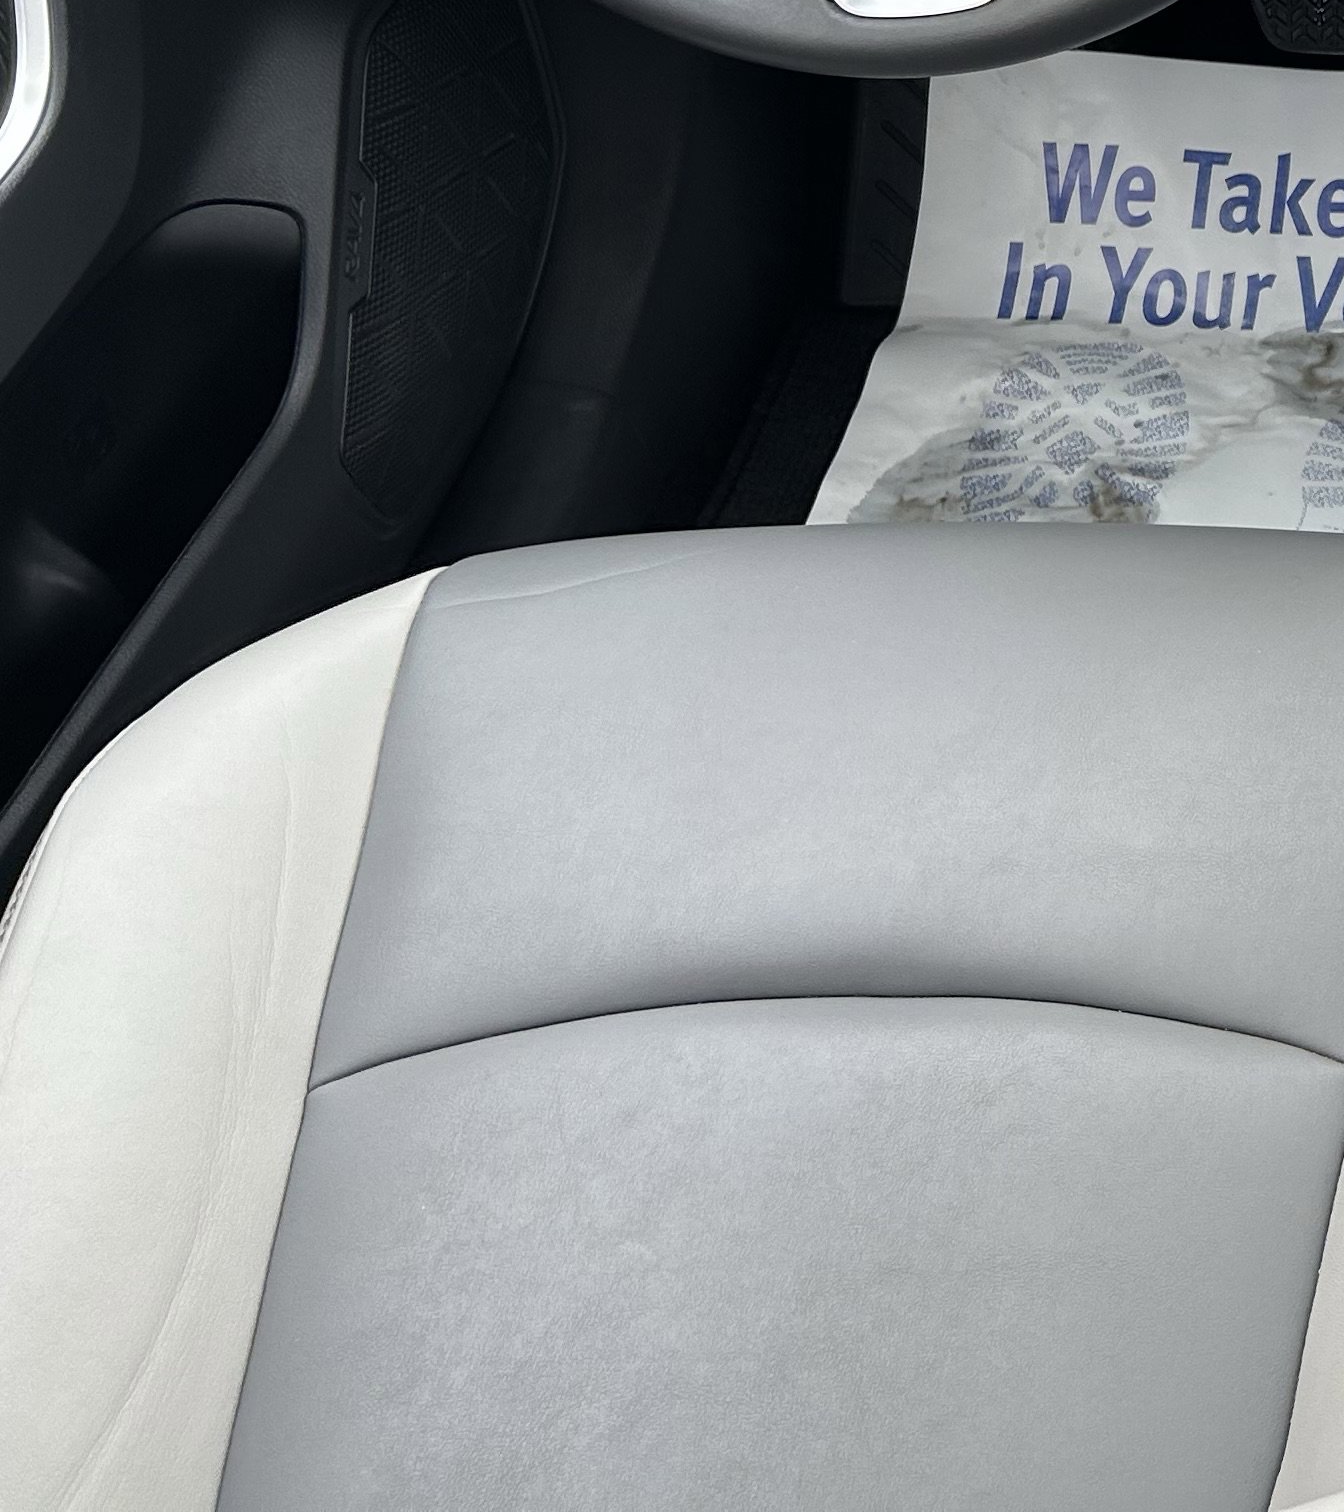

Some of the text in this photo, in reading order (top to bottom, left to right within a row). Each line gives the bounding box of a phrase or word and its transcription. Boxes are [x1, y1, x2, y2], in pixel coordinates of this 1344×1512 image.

[1042, 141, 1157, 228] We
[997, 241, 1073, 321] In
[1100, 244, 1278, 331] Your
